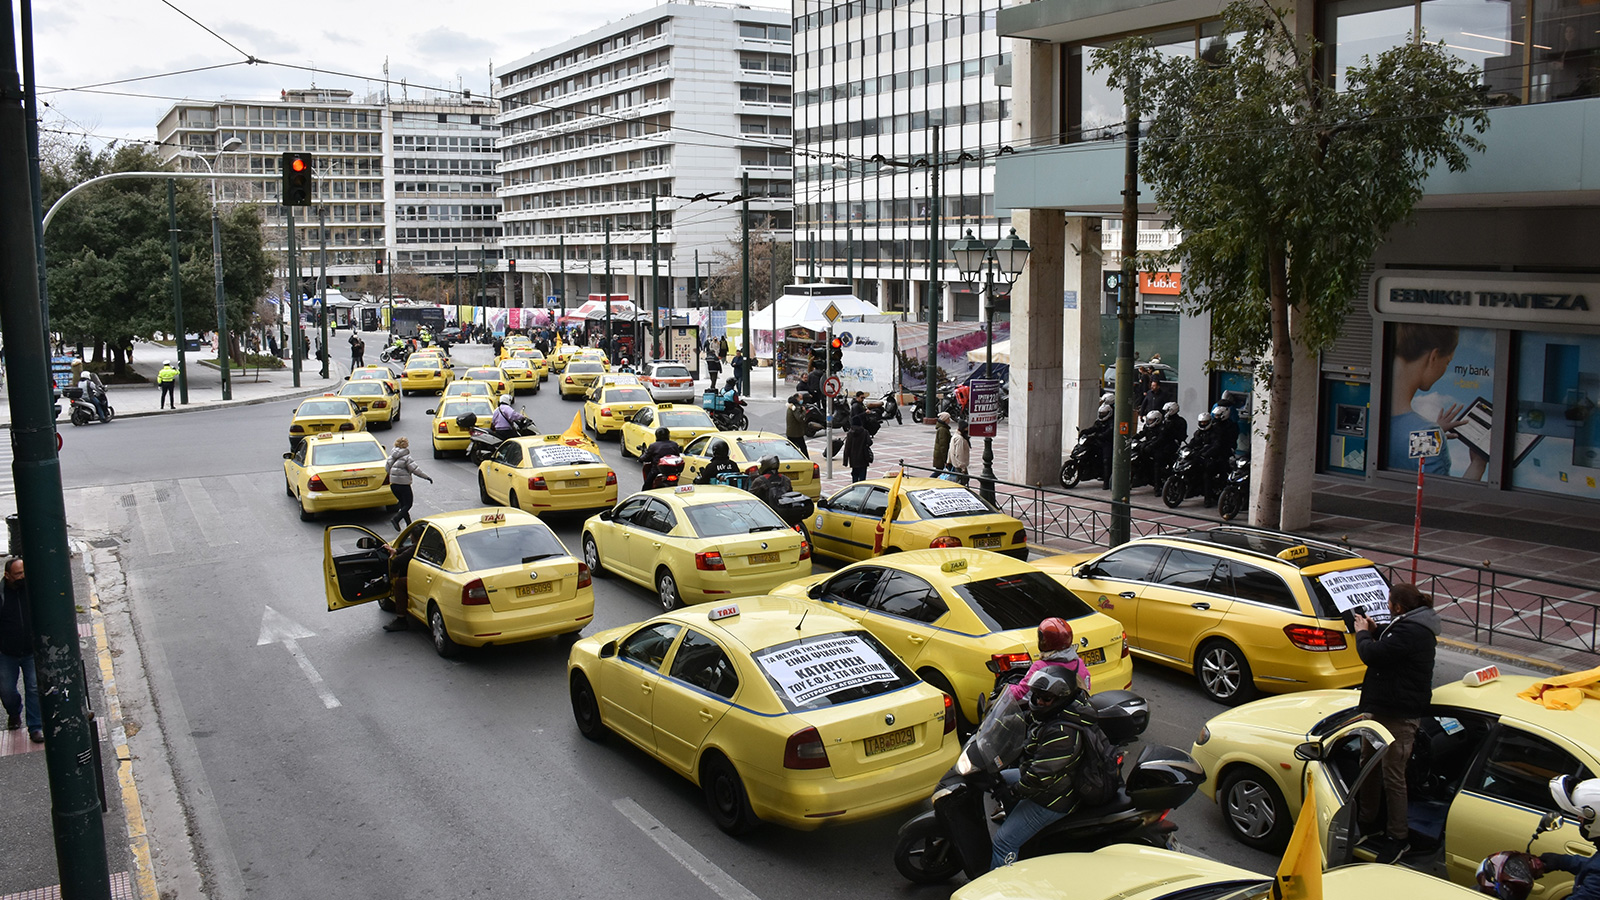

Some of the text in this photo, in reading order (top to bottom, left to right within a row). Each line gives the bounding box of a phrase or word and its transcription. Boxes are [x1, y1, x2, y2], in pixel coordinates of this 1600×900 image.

[1390, 288, 1590, 311] ΕΘΝΙΚΗ ΤΡΑΠΕΖΑ
[1454, 364, 1490, 377] my bank
[484, 513, 505, 521] TAXI
[1290, 547, 1306, 556] TAXI
[951, 561, 965, 569] TAXI
[717, 607, 737, 617] TAXI
[775, 649, 802, 661] ΜΕΤΡΑ
[814, 638, 859, 650] ΚΥΒΕΡΝΗΣΗΣ
[786, 646, 854, 667] ΕΙΝΑΙ ΨΙΧΟΥΛΑ
[795, 656, 867, 680] ΚΑΤΑΡΓΗΣΗ
[1476, 666, 1499, 683] TAXI
[788, 681, 807, 694] ΤΟΥ
[833, 669, 851, 680] ΣΤΑ
[849, 663, 888, 676] ΚΑΥΣΙΜΑ
